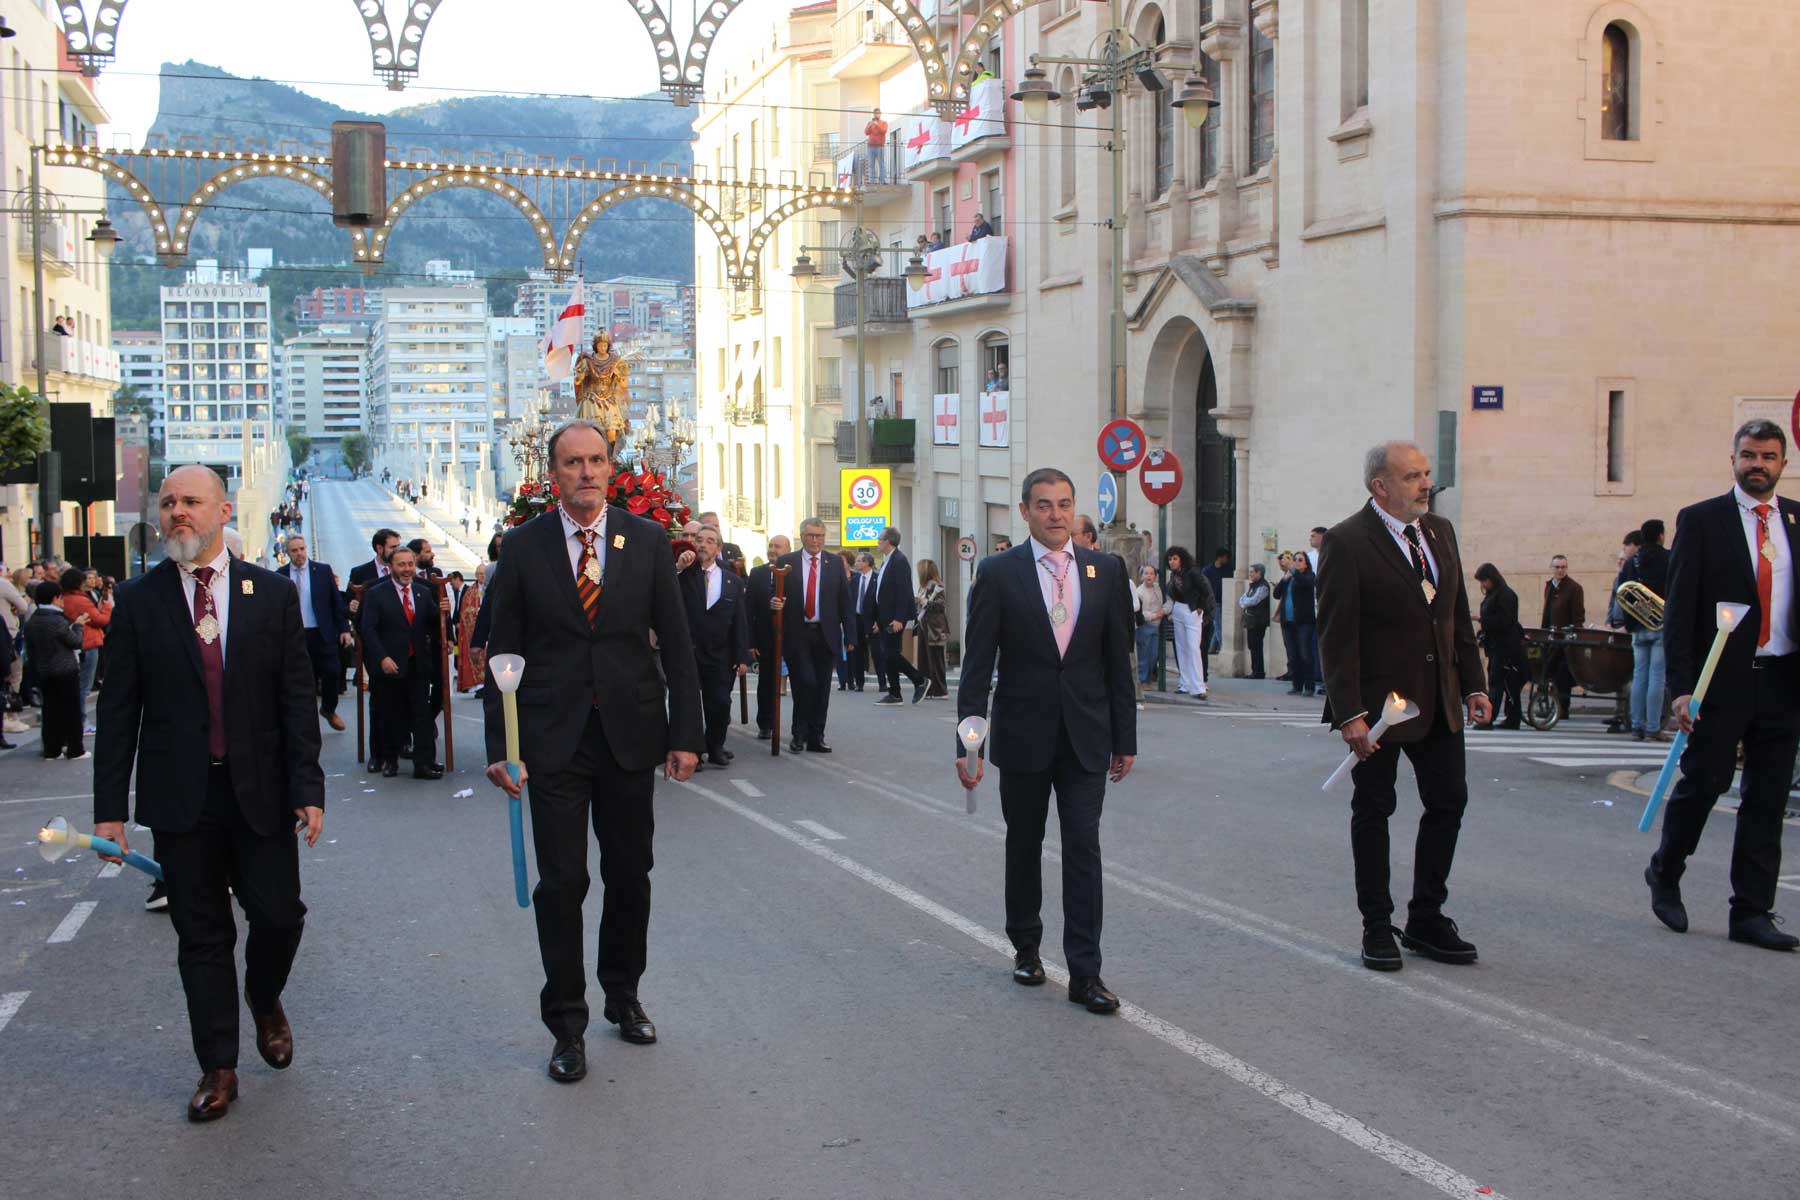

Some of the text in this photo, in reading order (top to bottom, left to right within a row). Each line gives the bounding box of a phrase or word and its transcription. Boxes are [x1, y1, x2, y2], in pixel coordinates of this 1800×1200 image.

[186, 270, 243, 285] HOTEL
[168, 287, 262, 298] RECONQUISTA
[857, 487, 875, 499] 30
